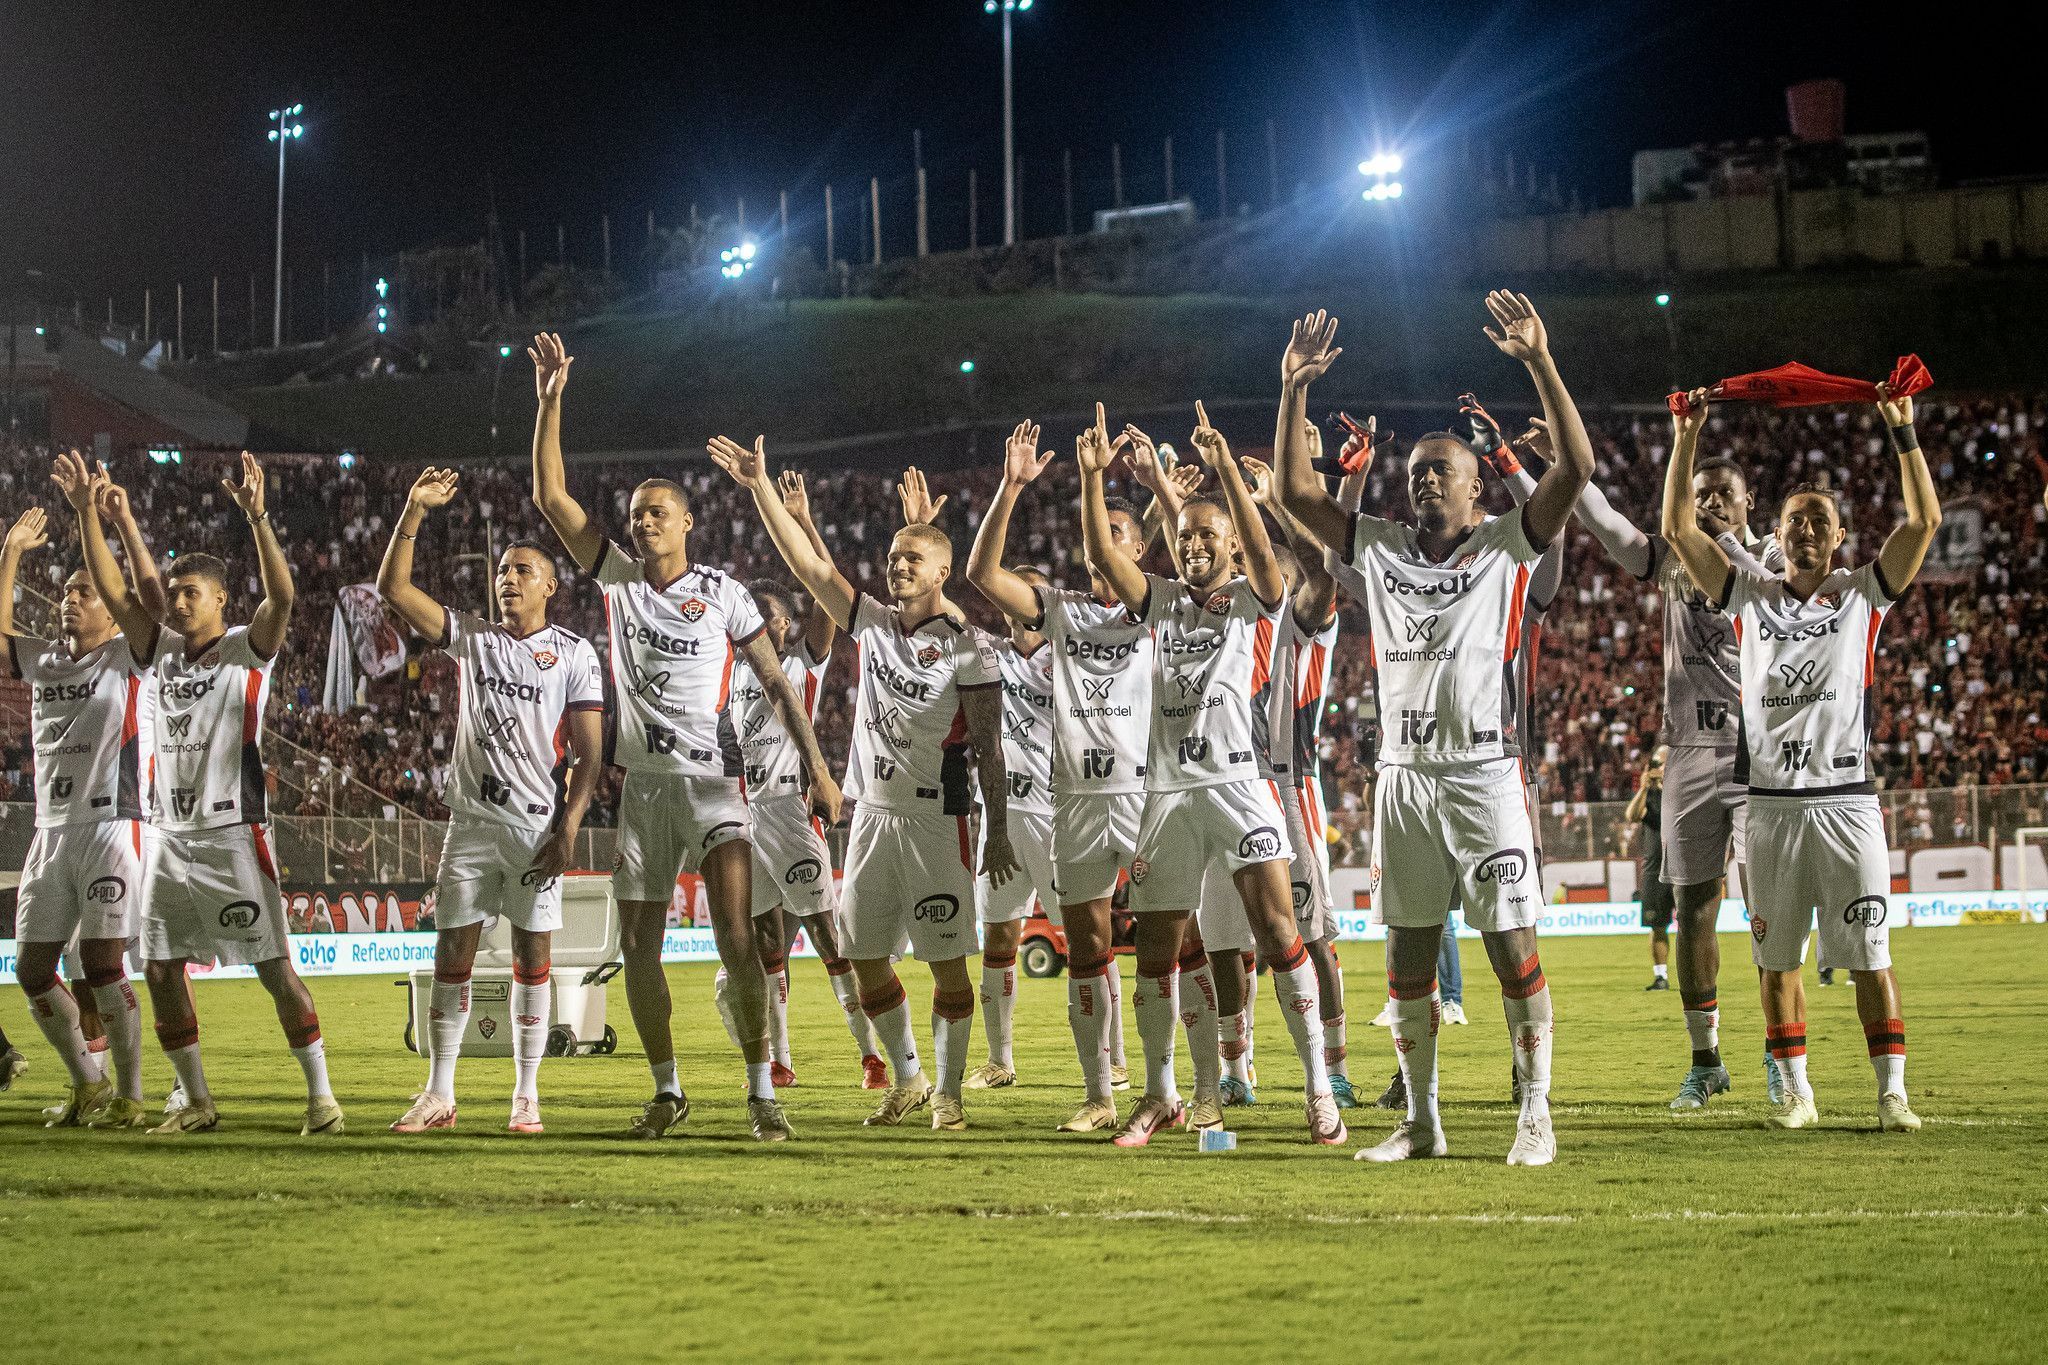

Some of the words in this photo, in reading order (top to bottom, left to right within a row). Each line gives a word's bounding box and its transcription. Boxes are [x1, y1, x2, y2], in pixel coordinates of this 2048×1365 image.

[622, 616, 700, 656] betsat
[1065, 634, 1139, 661] betsat
[1385, 647, 1456, 663] fatalmodel
[475, 665, 543, 704] betsat
[867, 651, 930, 702] betsat
[1761, 689, 1837, 708] fatalmodel
[1508, 894, 1529, 904] VOLT
[1558, 911, 1638, 928] olhinho?
[352, 942, 400, 962] Reflexo
